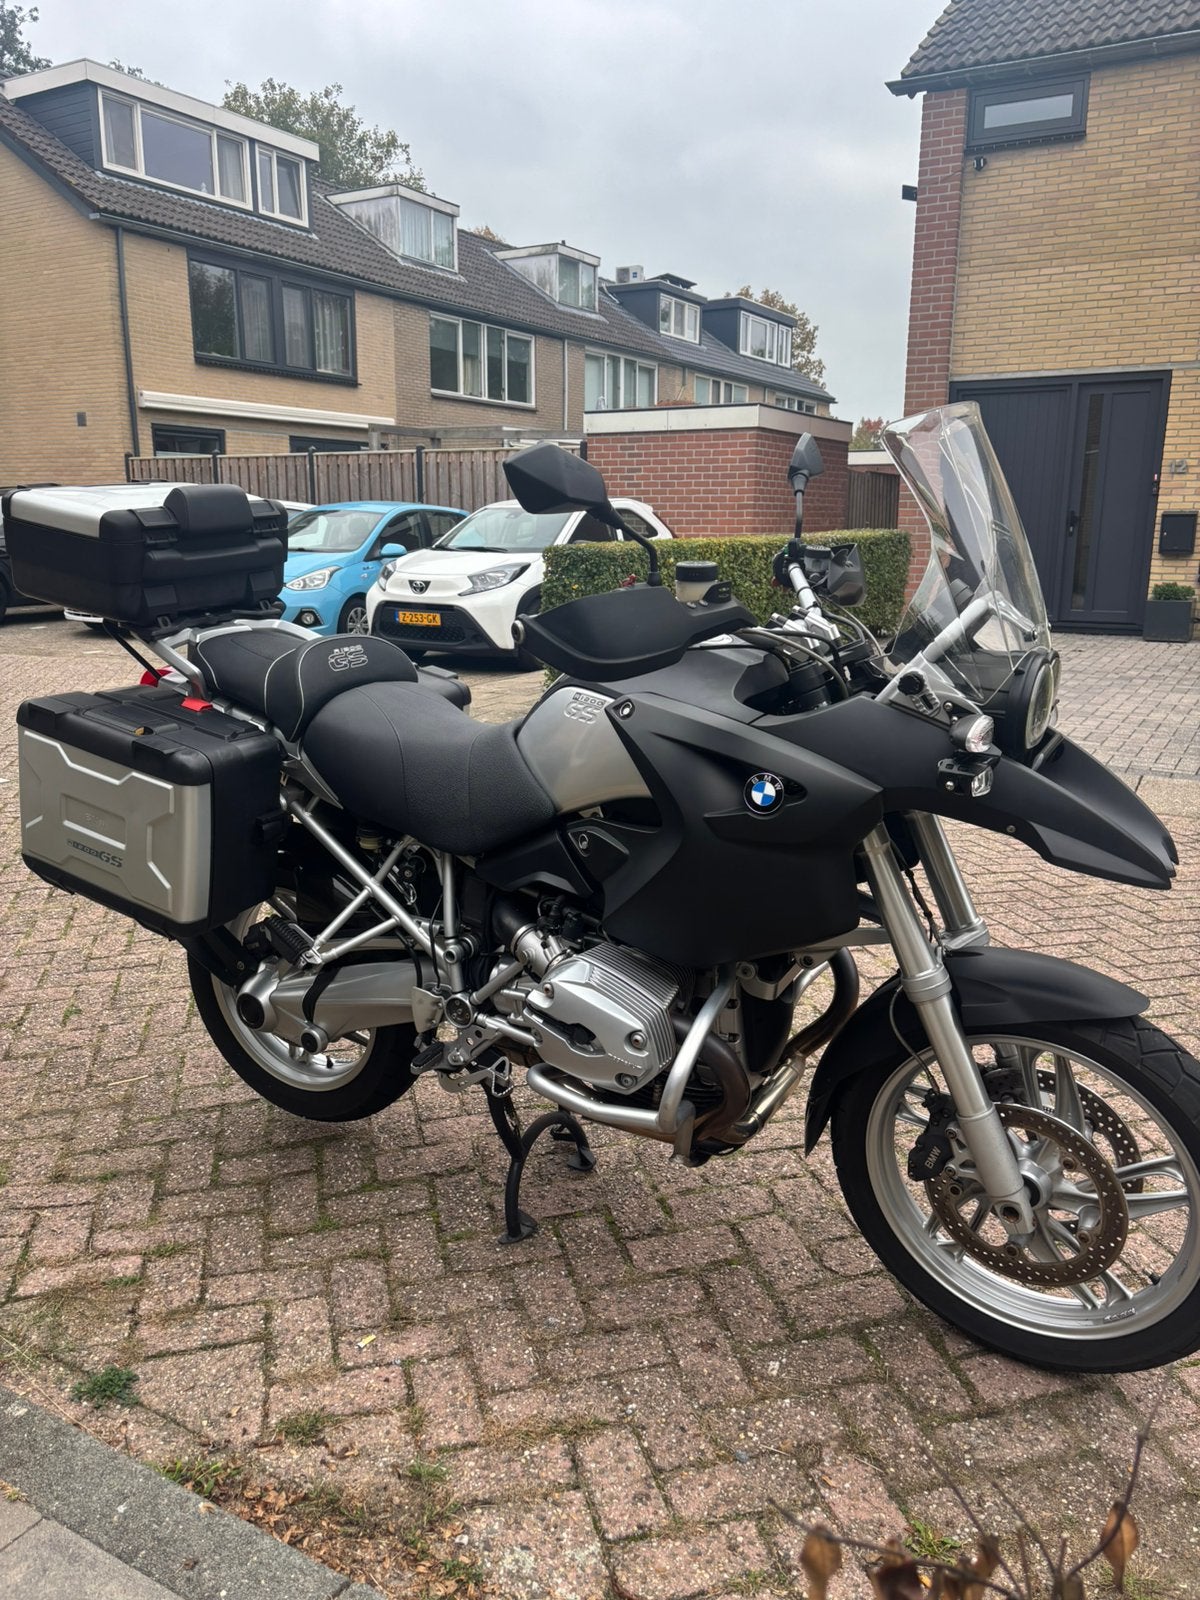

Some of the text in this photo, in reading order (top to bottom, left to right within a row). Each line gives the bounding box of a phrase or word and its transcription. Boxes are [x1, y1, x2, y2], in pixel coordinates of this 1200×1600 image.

[1170, 459, 1187, 474] 12
[401, 612, 438, 624] Z-253-GK
[328, 648, 368, 671] GS
[564, 701, 602, 724] GS
[751, 774, 782, 790] BMW
[924, 1145, 941, 1169] BMW
